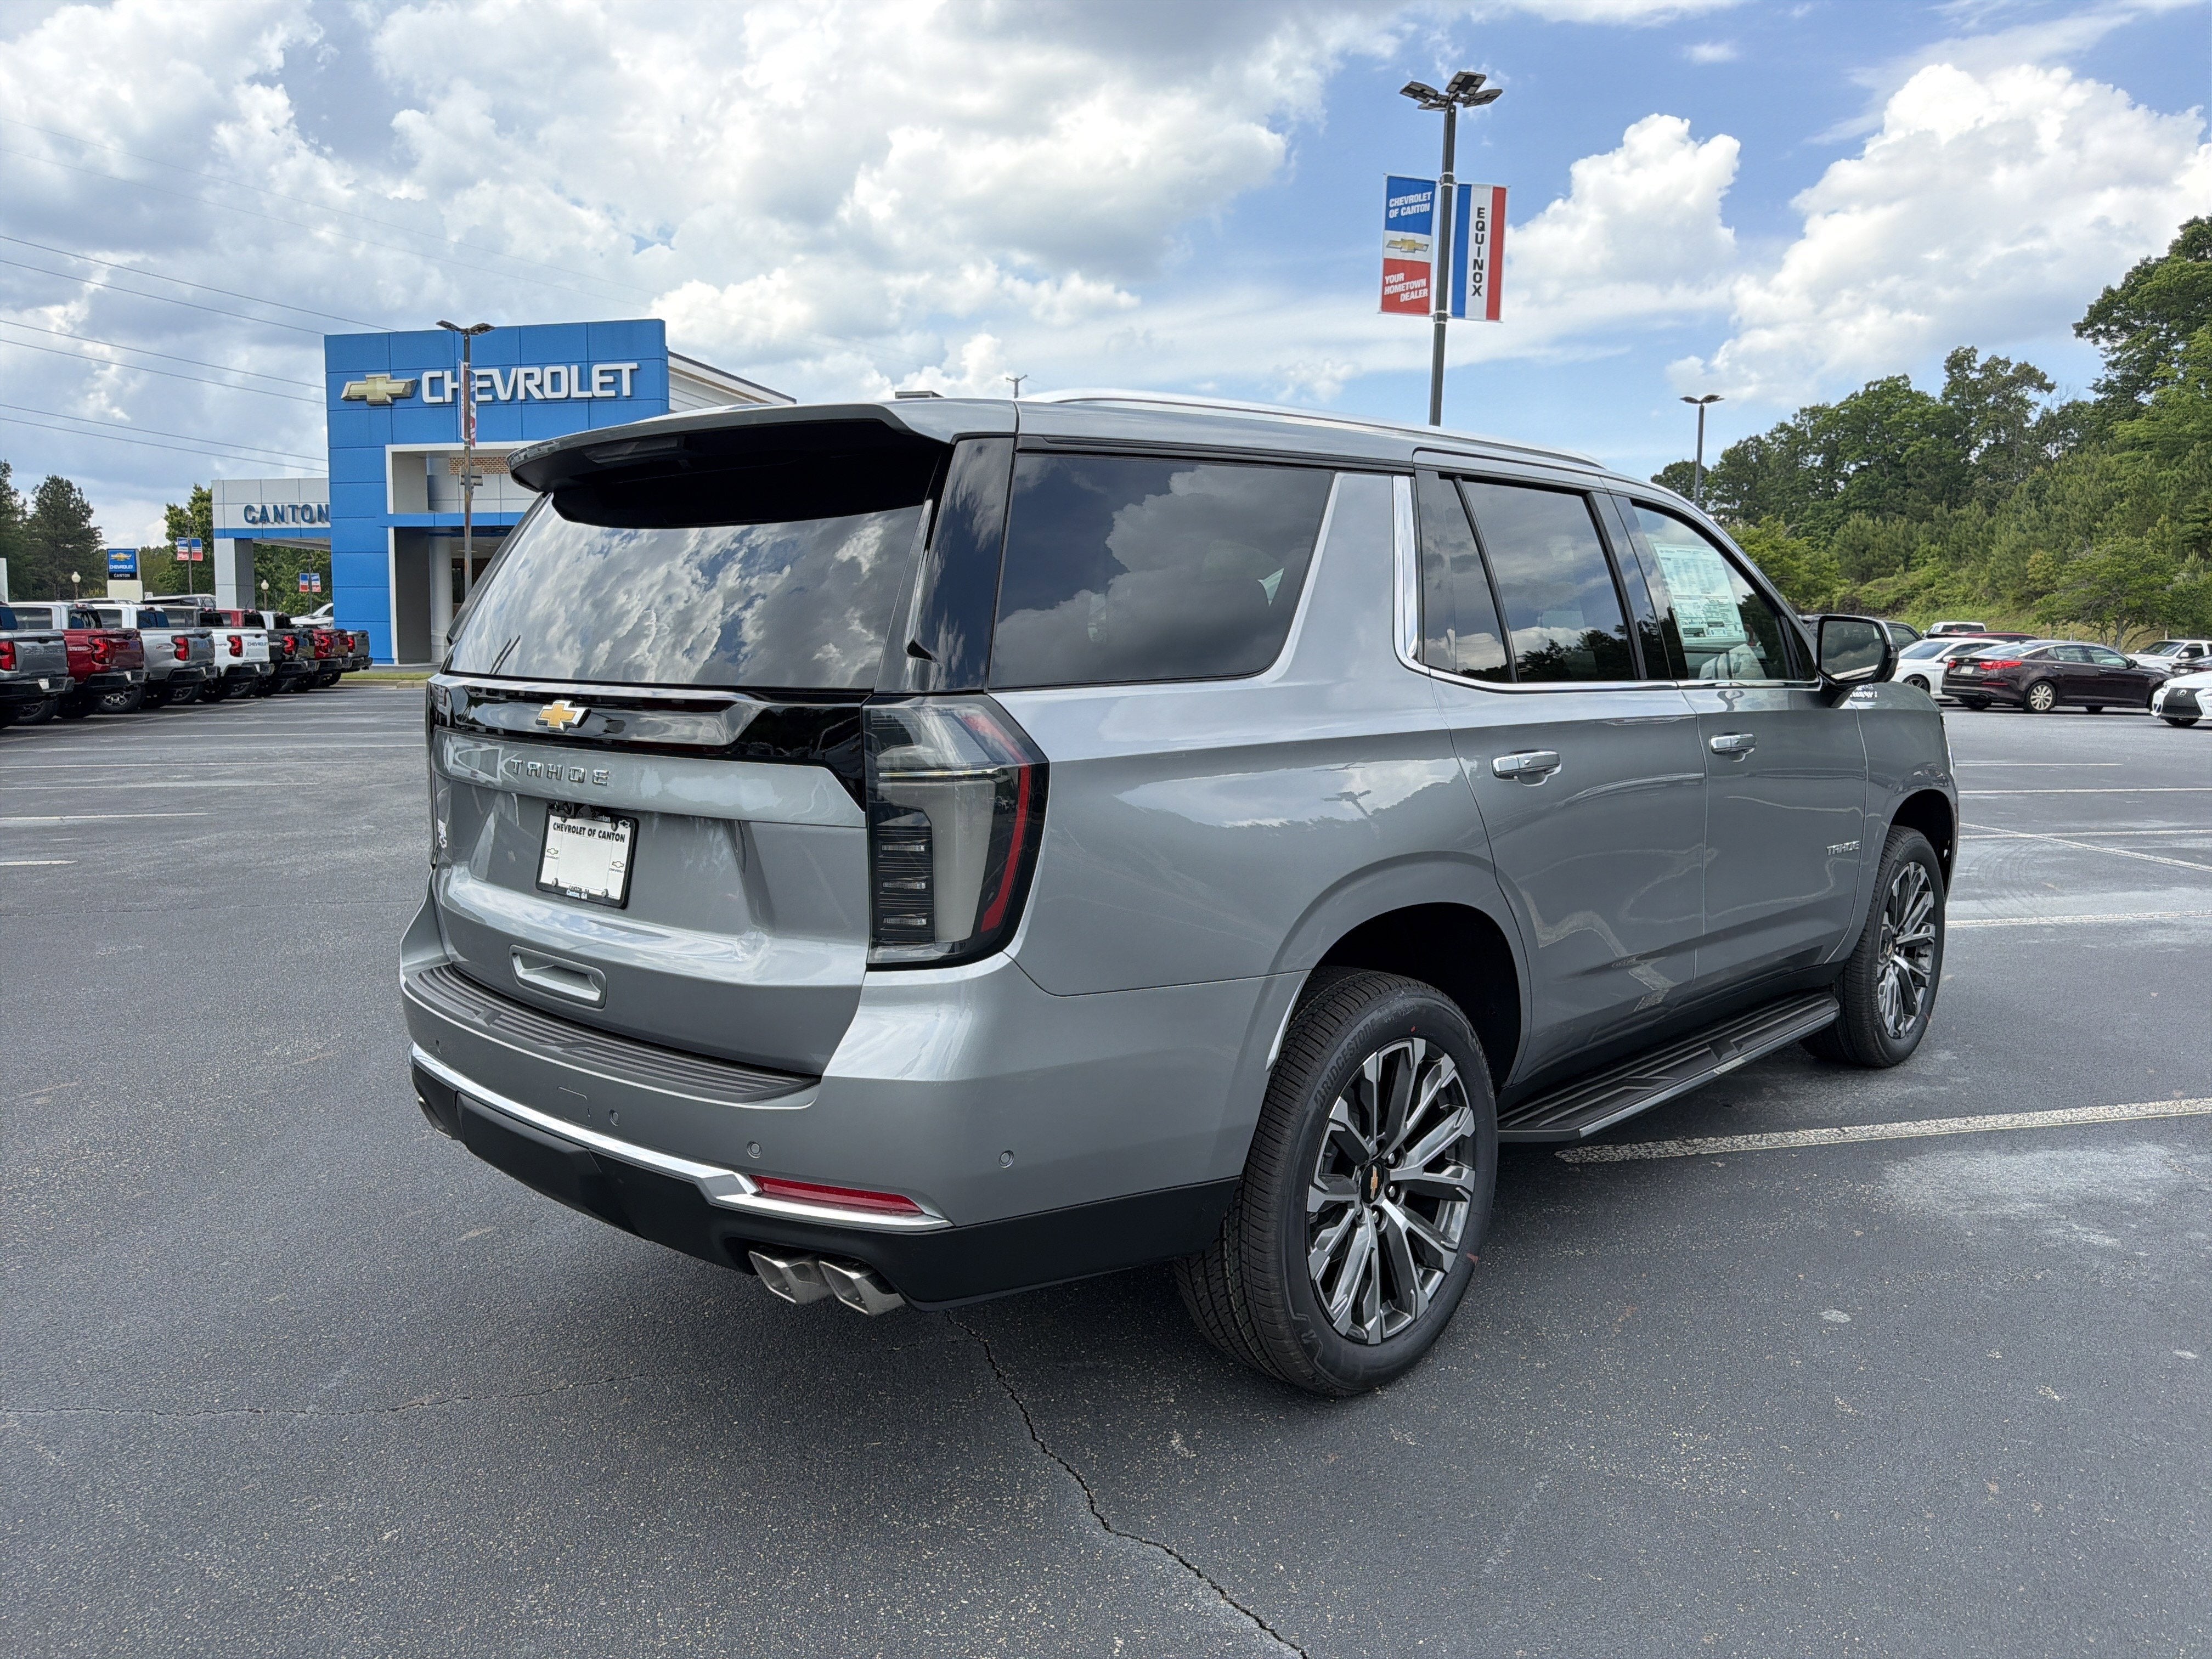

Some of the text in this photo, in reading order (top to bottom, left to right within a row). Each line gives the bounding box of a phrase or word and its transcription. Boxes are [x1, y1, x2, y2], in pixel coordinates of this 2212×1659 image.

[1389, 191, 1432, 208] CHEVROLET
[1389, 203, 1430, 218] OF CANTON
[1471, 207, 1486, 297] EQUINOX
[1384, 278, 1426, 295] HOMETOWN
[1385, 273, 1404, 284] YOUR
[1400, 289, 1428, 302] DEALER
[422, 363, 638, 403] CHEVROLET
[244, 504, 329, 524] CANTON
[511, 759, 610, 786] TAHOE
[553, 822, 625, 843] CHEVROLET OF CANTON
[1826, 840, 1860, 855] TAHOE
[1314, 1018, 1377, 1107] BRIDGESTONE
